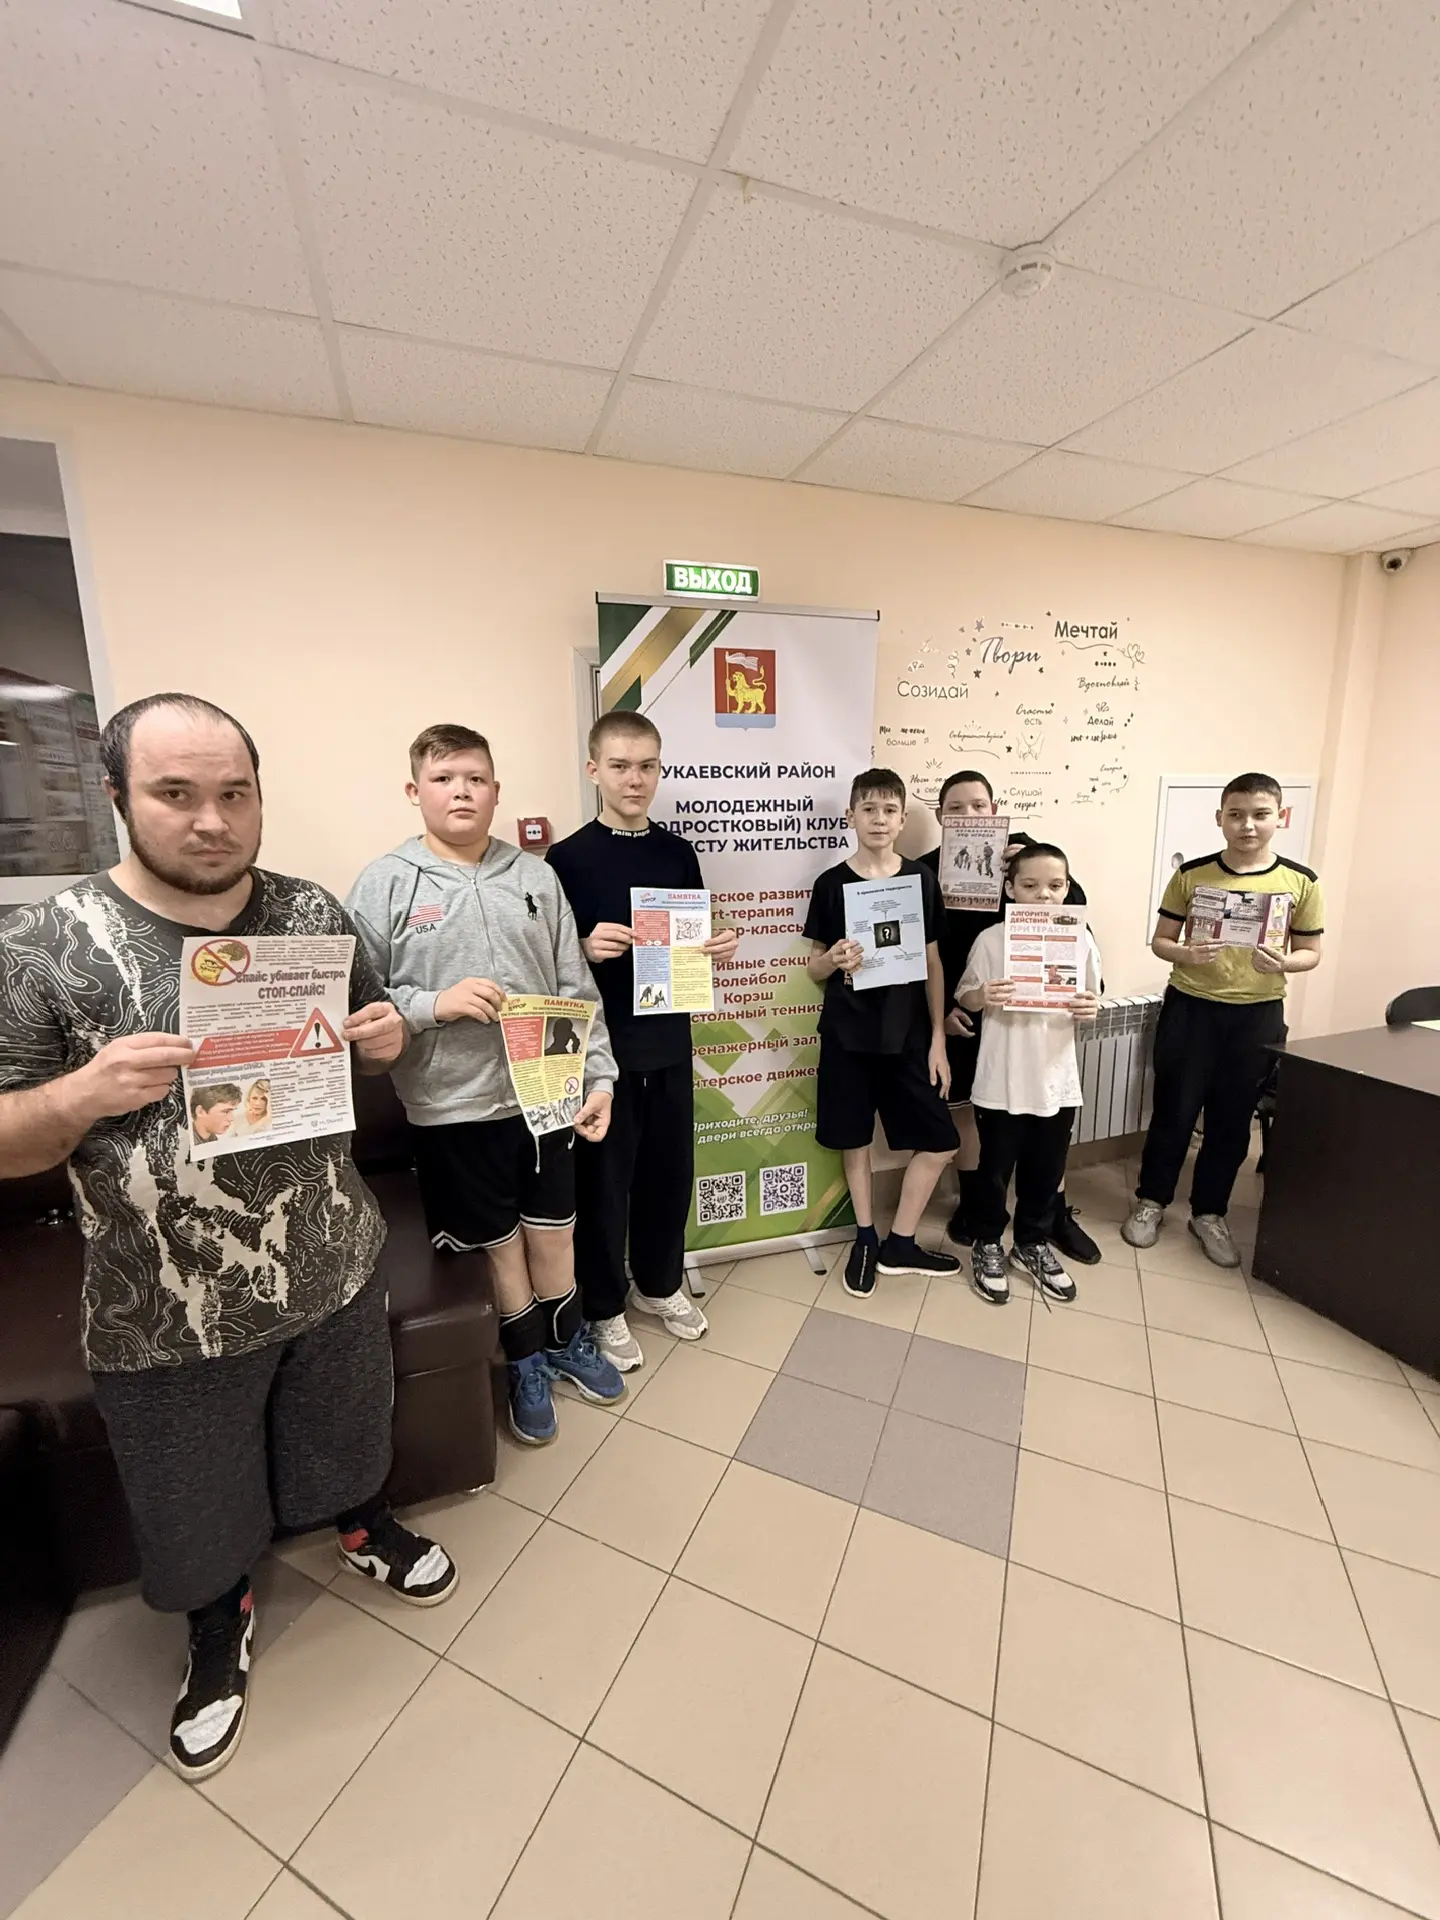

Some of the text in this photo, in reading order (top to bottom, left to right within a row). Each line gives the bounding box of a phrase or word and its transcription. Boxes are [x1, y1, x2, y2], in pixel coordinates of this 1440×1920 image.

[673, 567, 752, 594] ВЫХОД
[1054, 620, 1118, 639] Мечтай
[980, 636, 1041, 674] Твори
[897, 680, 968, 699] Созидай
[1024, 717, 1042, 726] есть
[1087, 716, 1114, 726] Делай
[886, 738, 916, 746] больше
[661, 762, 836, 779] УКАЕВСКИЙ РАЙОН
[1009, 787, 1042, 798] Слушай
[675, 796, 813, 815] МОЛОДЕЖНЫЙ
[657, 816, 848, 835] ОДРОСТКОВЫЙ) КЛУБ
[690, 836, 849, 853] СТУ ЖИТЕЛЬСТВА
[710, 889, 813, 903] еское развит
[711, 906, 794, 921] rt-терапия
[415, 922, 437, 935] USA
[1010, 925, 1069, 933] ПРИ ТЕРАКТЕ
[269, 970, 310, 984] убивает
[258, 983, 326, 999] СТОП-СПАЙС!
[723, 991, 773, 1004] Корэш
[544, 999, 584, 1009] ПАМЯТКА
[691, 1003, 824, 1023] стольный теннис
[692, 1035, 817, 1056] енажерный зал
[693, 1067, 819, 1088] нтерское движе
[762, 1108, 808, 1124] друзья!
[698, 1121, 817, 1145] двери всегда откр
